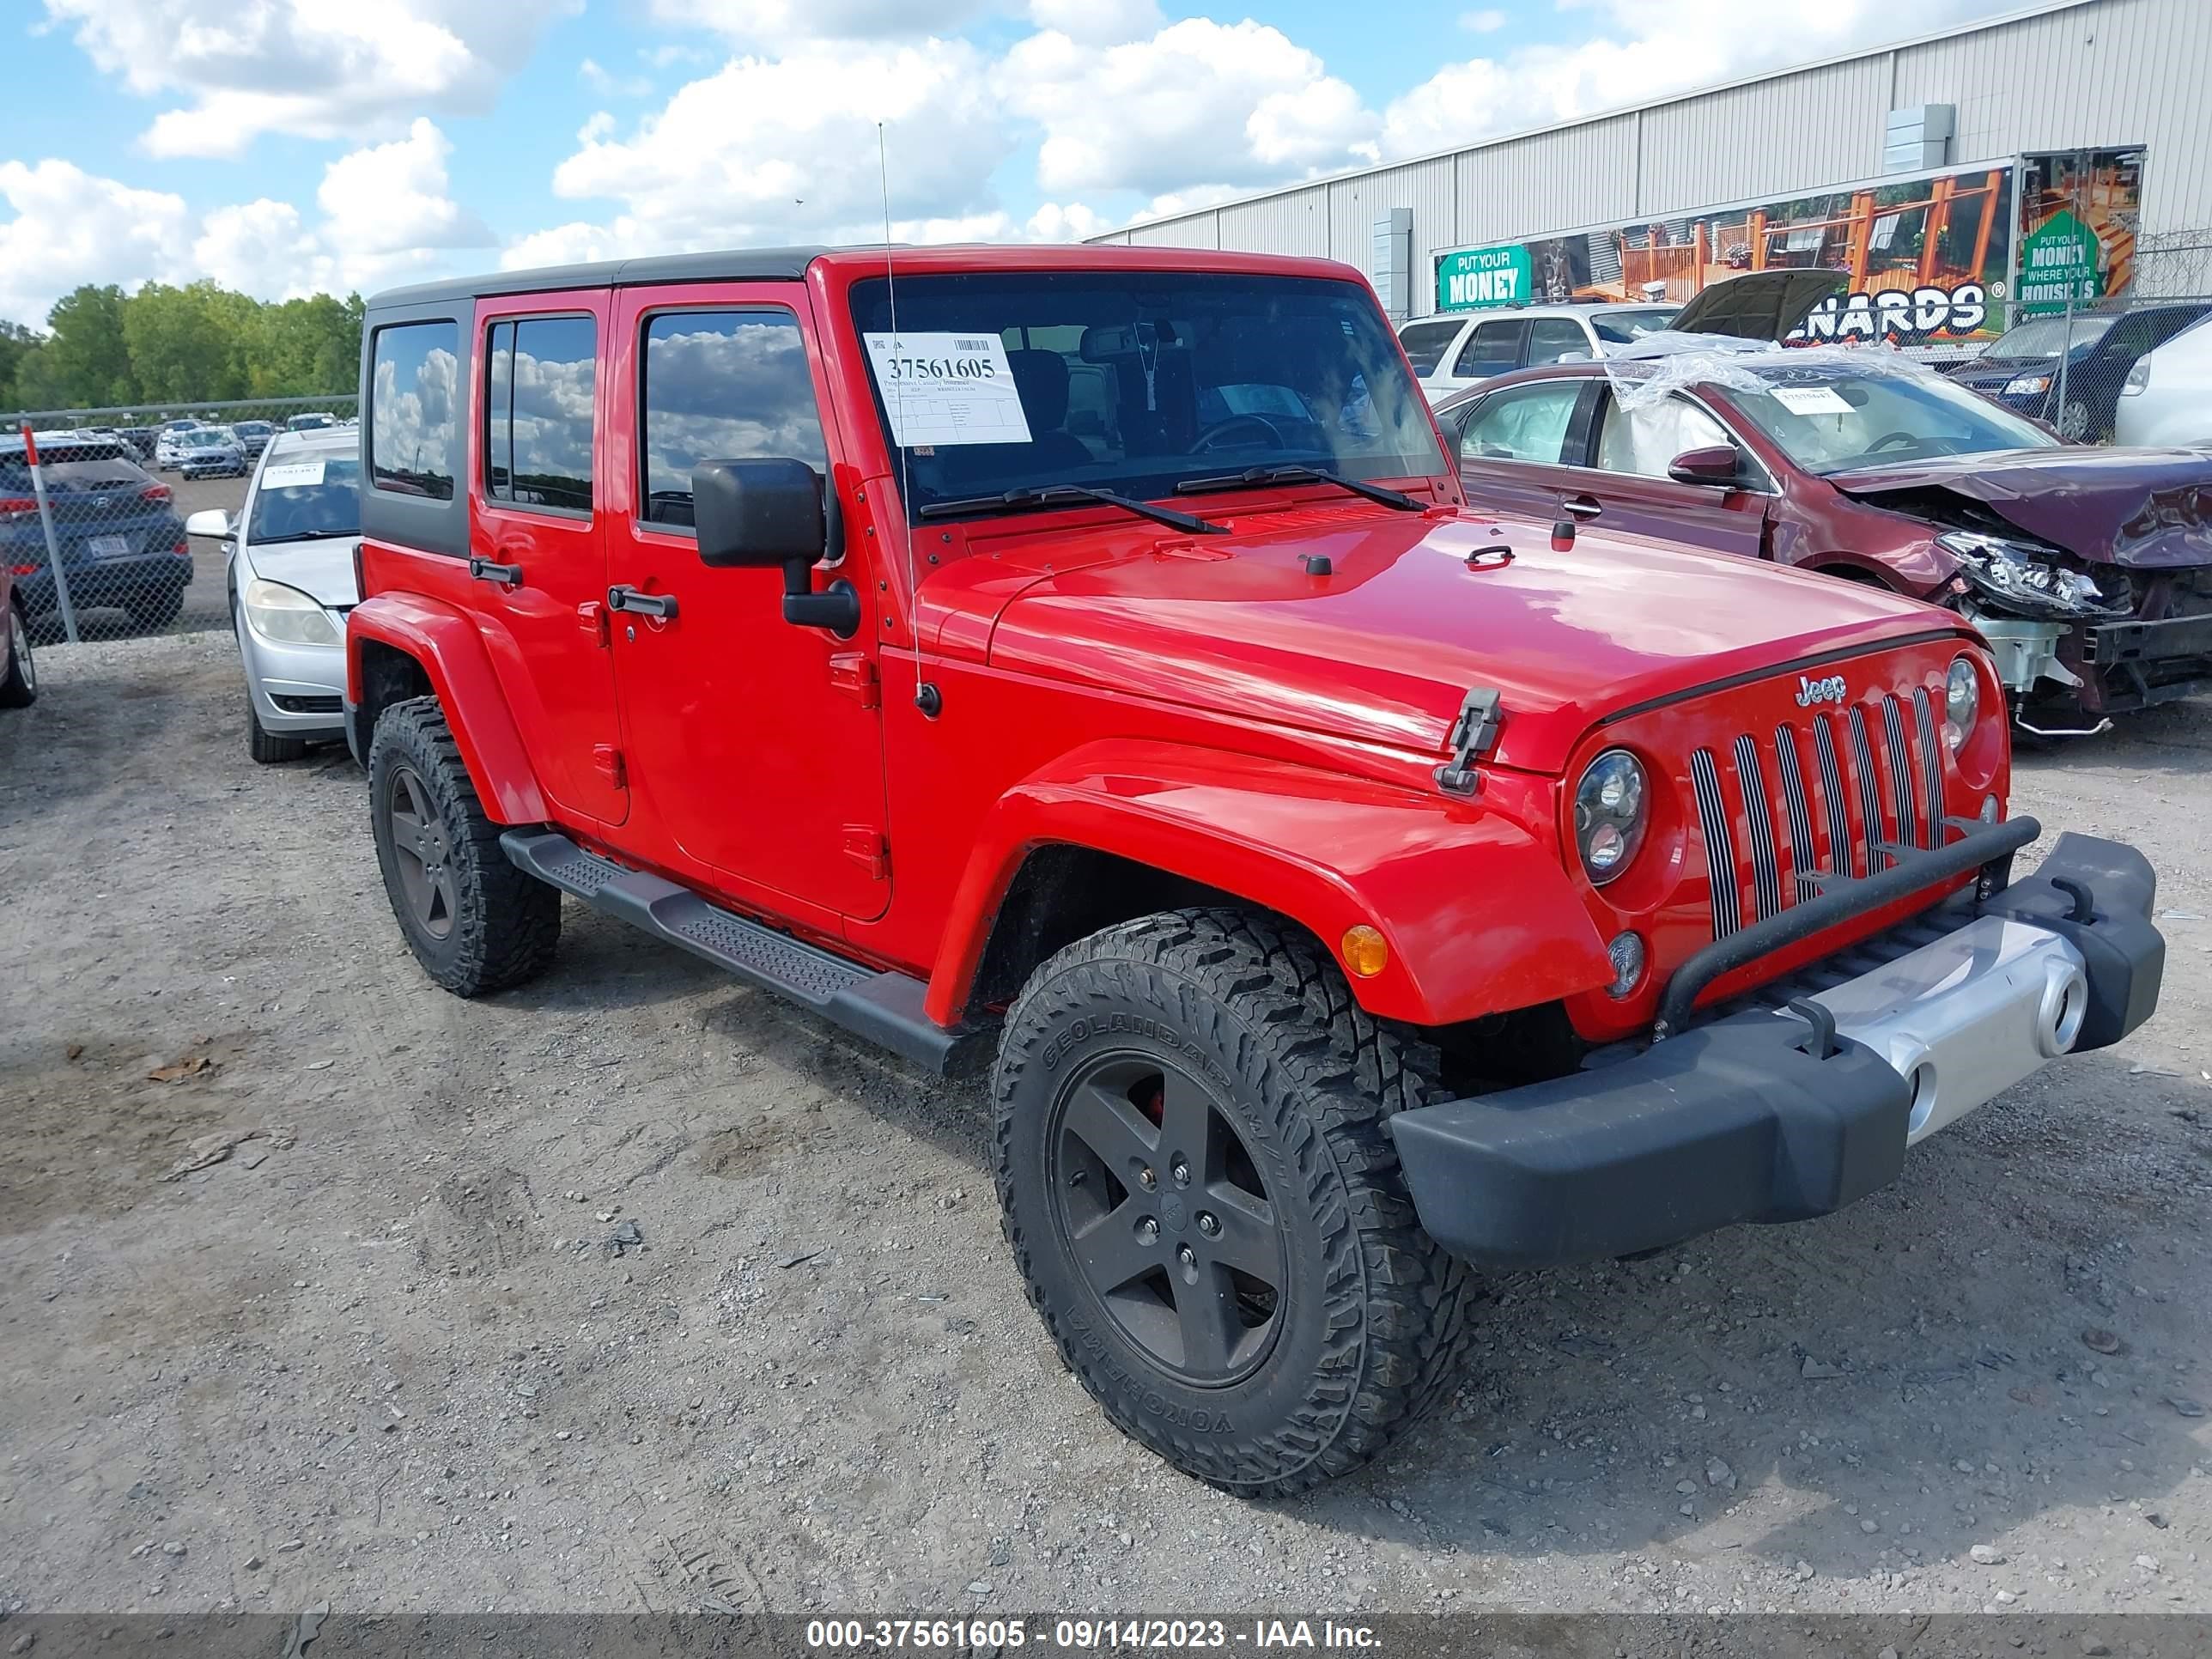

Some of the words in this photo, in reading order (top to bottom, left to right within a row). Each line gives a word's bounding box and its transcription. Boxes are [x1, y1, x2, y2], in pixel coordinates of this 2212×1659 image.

[2040, 236, 2056, 246] PUT
[1457, 256, 1478, 271] PUT
[1479, 252, 1510, 269] YOUR
[2032, 245, 2084, 267] MONEY
[1449, 267, 1519, 305] MONEY
[2028, 270, 2063, 281] WHERE
[2022, 283, 2074, 301] HOUSE
[887, 358, 995, 379] 37561605
[1795, 676, 1846, 707] Jeep
[1041, 1012, 1232, 1088] GEOLANDAR
[1064, 1305, 1236, 1434] YOKOHAMA
